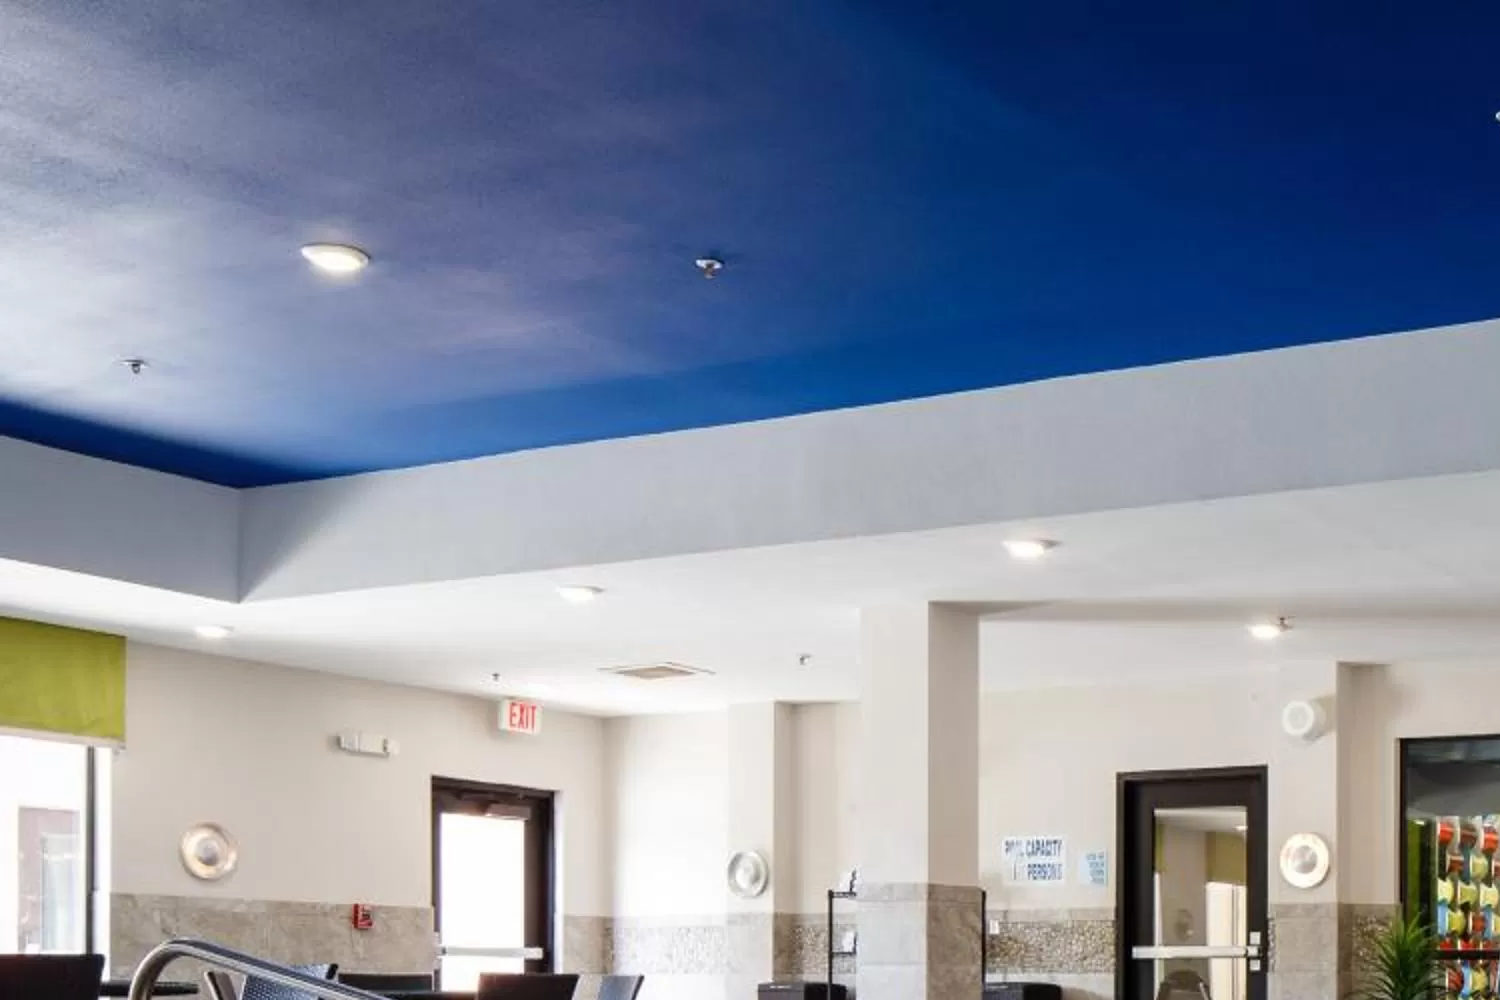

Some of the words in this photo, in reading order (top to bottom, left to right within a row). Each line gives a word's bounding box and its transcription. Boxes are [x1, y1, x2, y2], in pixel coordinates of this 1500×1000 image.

[510, 702, 537, 730] EXIT
[1005, 840, 1025, 856] PL
[1026, 839, 1062, 856] CAPACITY
